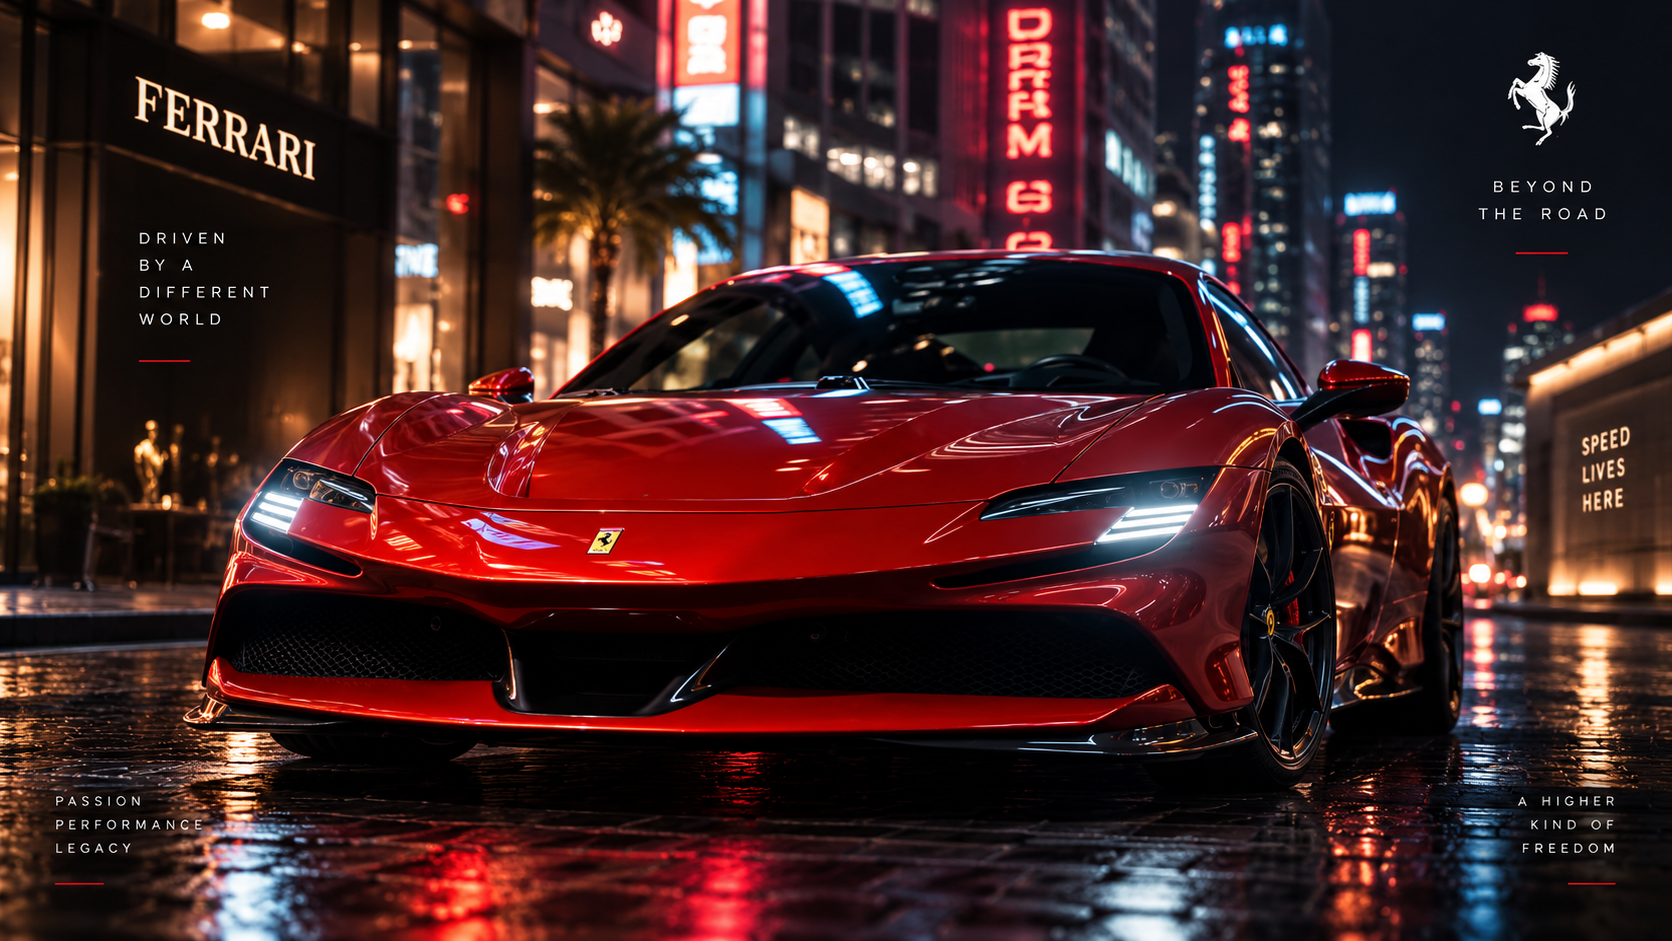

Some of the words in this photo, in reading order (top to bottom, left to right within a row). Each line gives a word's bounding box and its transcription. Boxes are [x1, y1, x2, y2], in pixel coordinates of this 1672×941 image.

[134, 75, 316, 181] FERRARI
[1581, 425, 1631, 457] SPEED
[1582, 457, 1626, 484] LIVES
[1582, 487, 1624, 513] HERE
